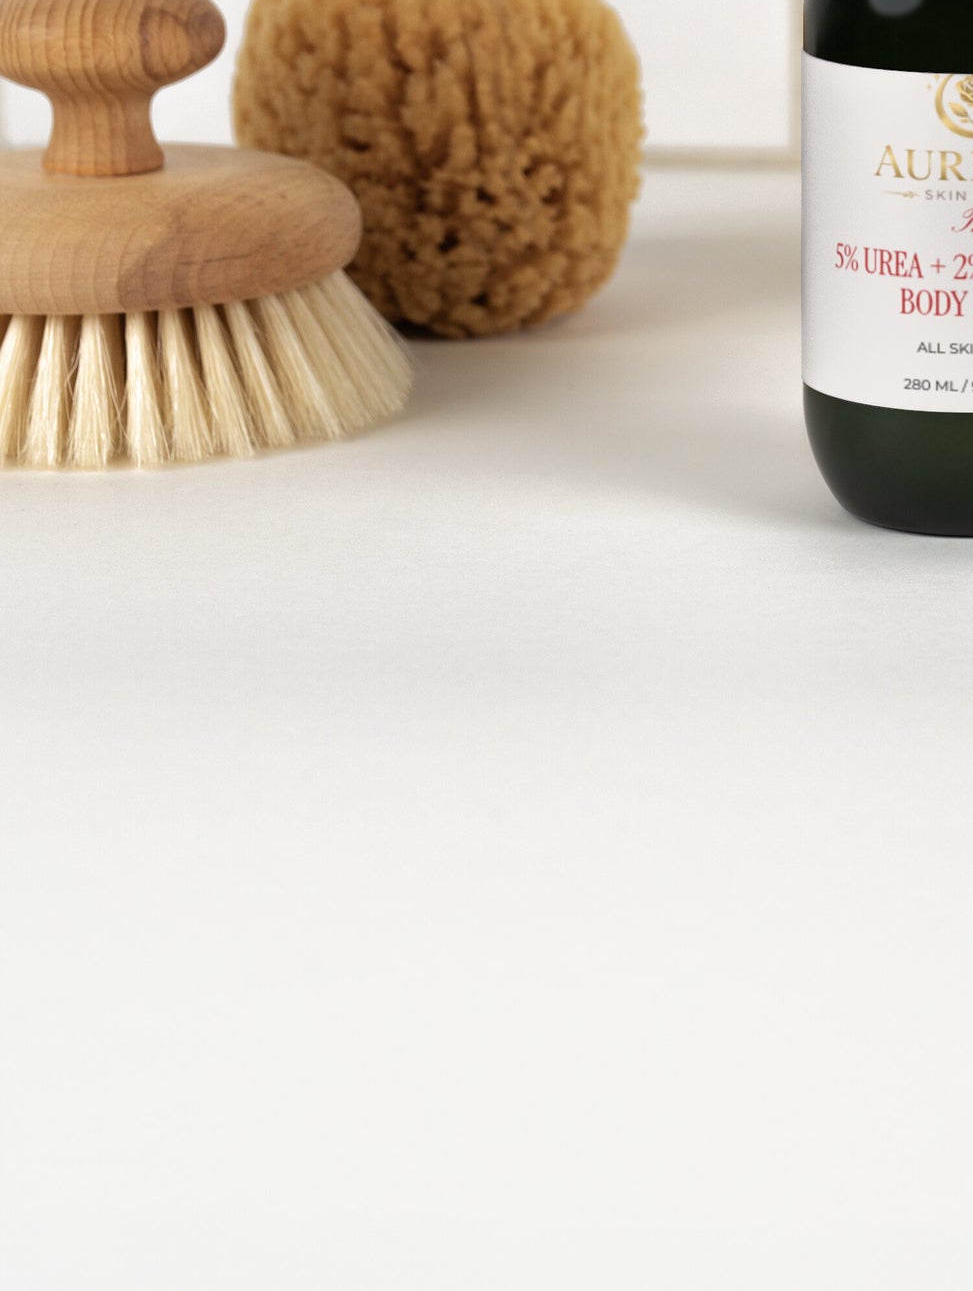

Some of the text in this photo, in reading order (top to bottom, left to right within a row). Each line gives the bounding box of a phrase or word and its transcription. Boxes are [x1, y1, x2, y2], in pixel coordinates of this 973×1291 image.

[924, 189, 967, 201] SKIN
[834, 242, 860, 272] 5%
[863, 248, 923, 279] UREA
[930, 258, 947, 274] +
[899, 287, 969, 317] BODY
[916, 342, 946, 354] ALL
[903, 378, 931, 391] 280
[935, 379, 959, 392] ML
[961, 379, 969, 392] /
